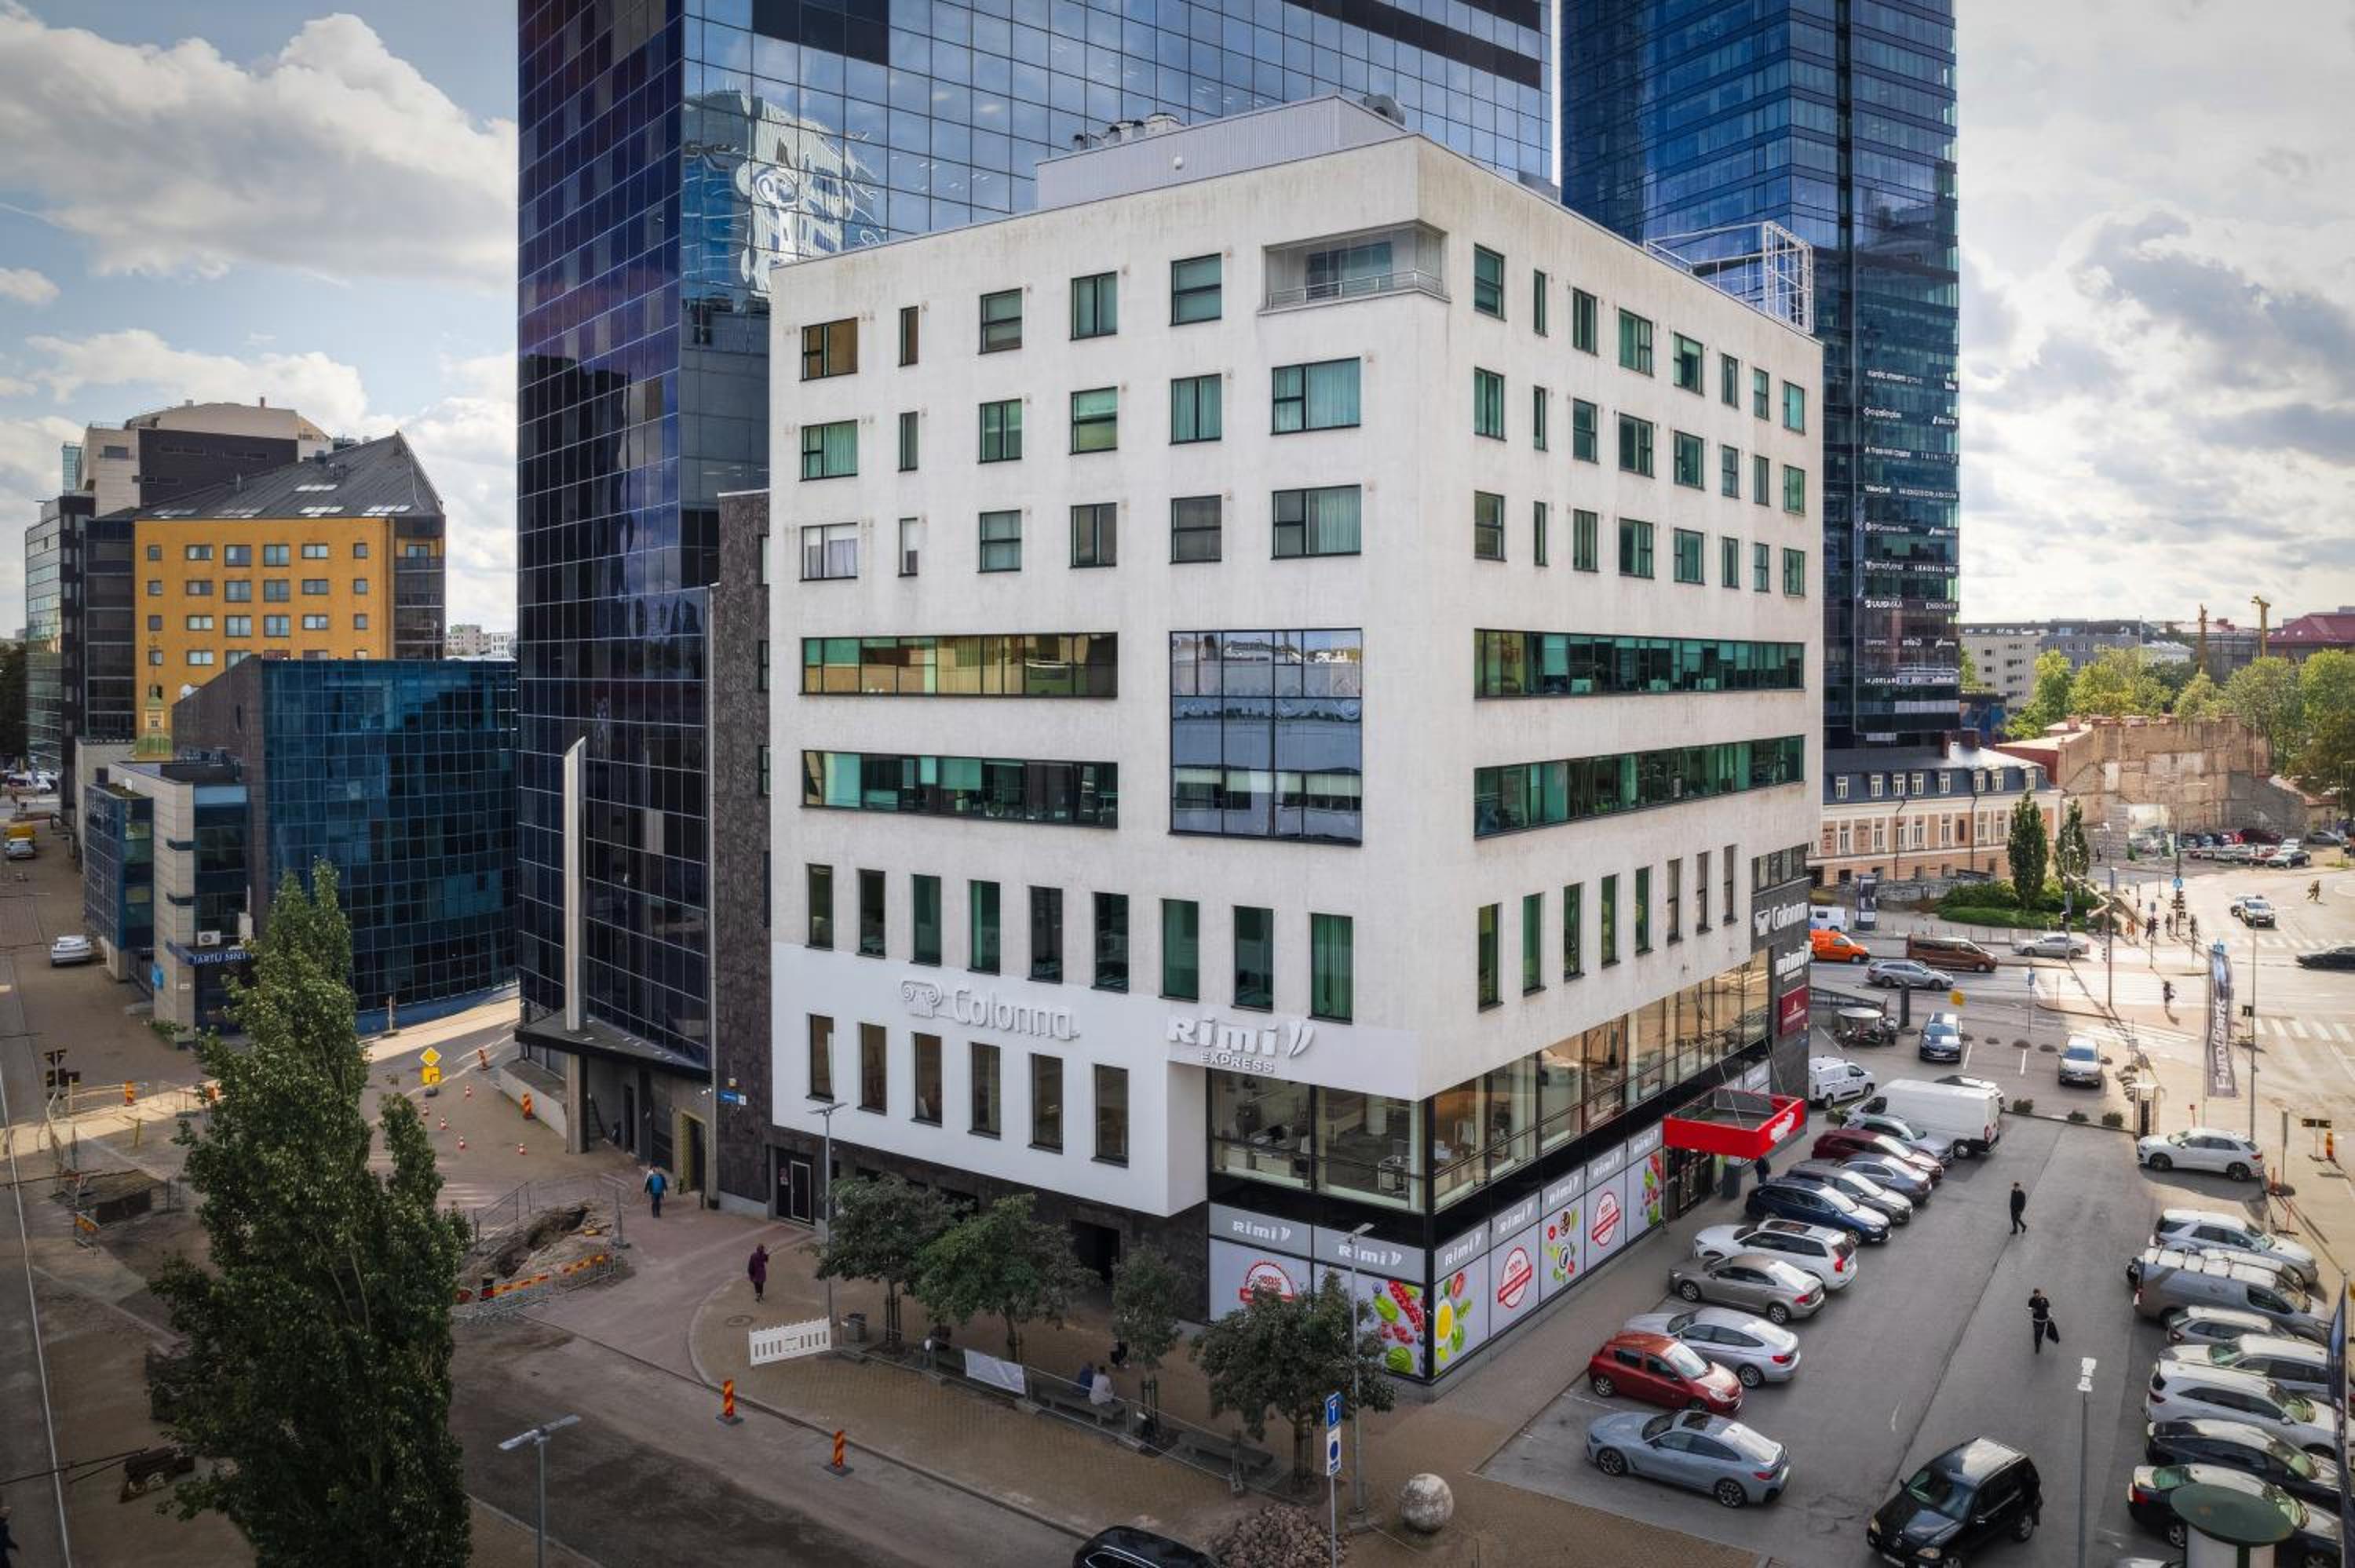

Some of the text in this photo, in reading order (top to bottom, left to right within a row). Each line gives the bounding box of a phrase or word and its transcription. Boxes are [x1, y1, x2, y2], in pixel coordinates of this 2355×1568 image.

[954, 983, 1080, 1041] Colonna
[1167, 1016, 1277, 1056] Rimi
[1199, 1050, 1275, 1074] EXPRESS
[1593, 1154, 1614, 1180] Rimi
[1548, 1180, 1572, 1205] Rimi
[1232, 1220, 1277, 1242] Rimi
[1499, 1208, 1525, 1234] Rimi
[1338, 1243, 1386, 1266] Rimi
[1444, 1239, 1473, 1267] Rimi
